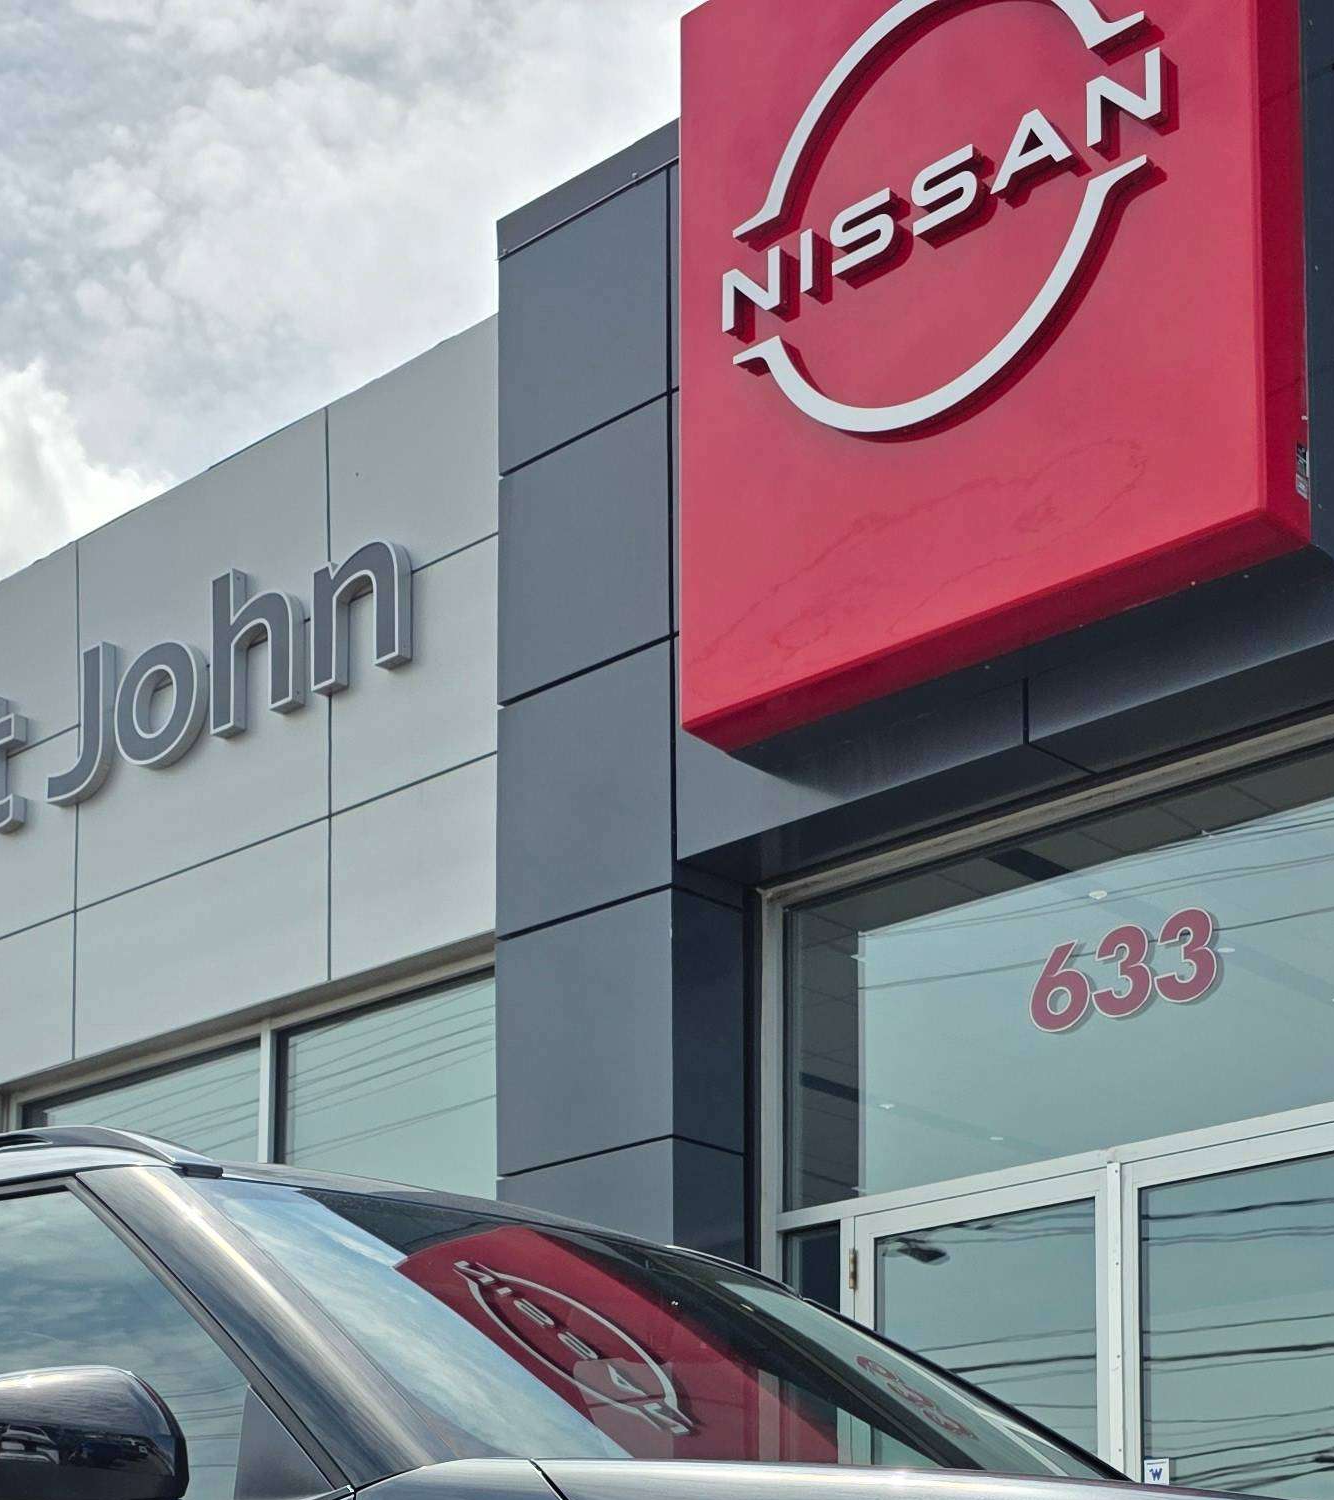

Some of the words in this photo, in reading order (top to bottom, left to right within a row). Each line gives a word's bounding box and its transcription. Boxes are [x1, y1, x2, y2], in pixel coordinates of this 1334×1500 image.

[722, 48, 1168, 338] NISSAN
[47, 539, 413, 806] John
[1029, 907, 1217, 1032] 633
